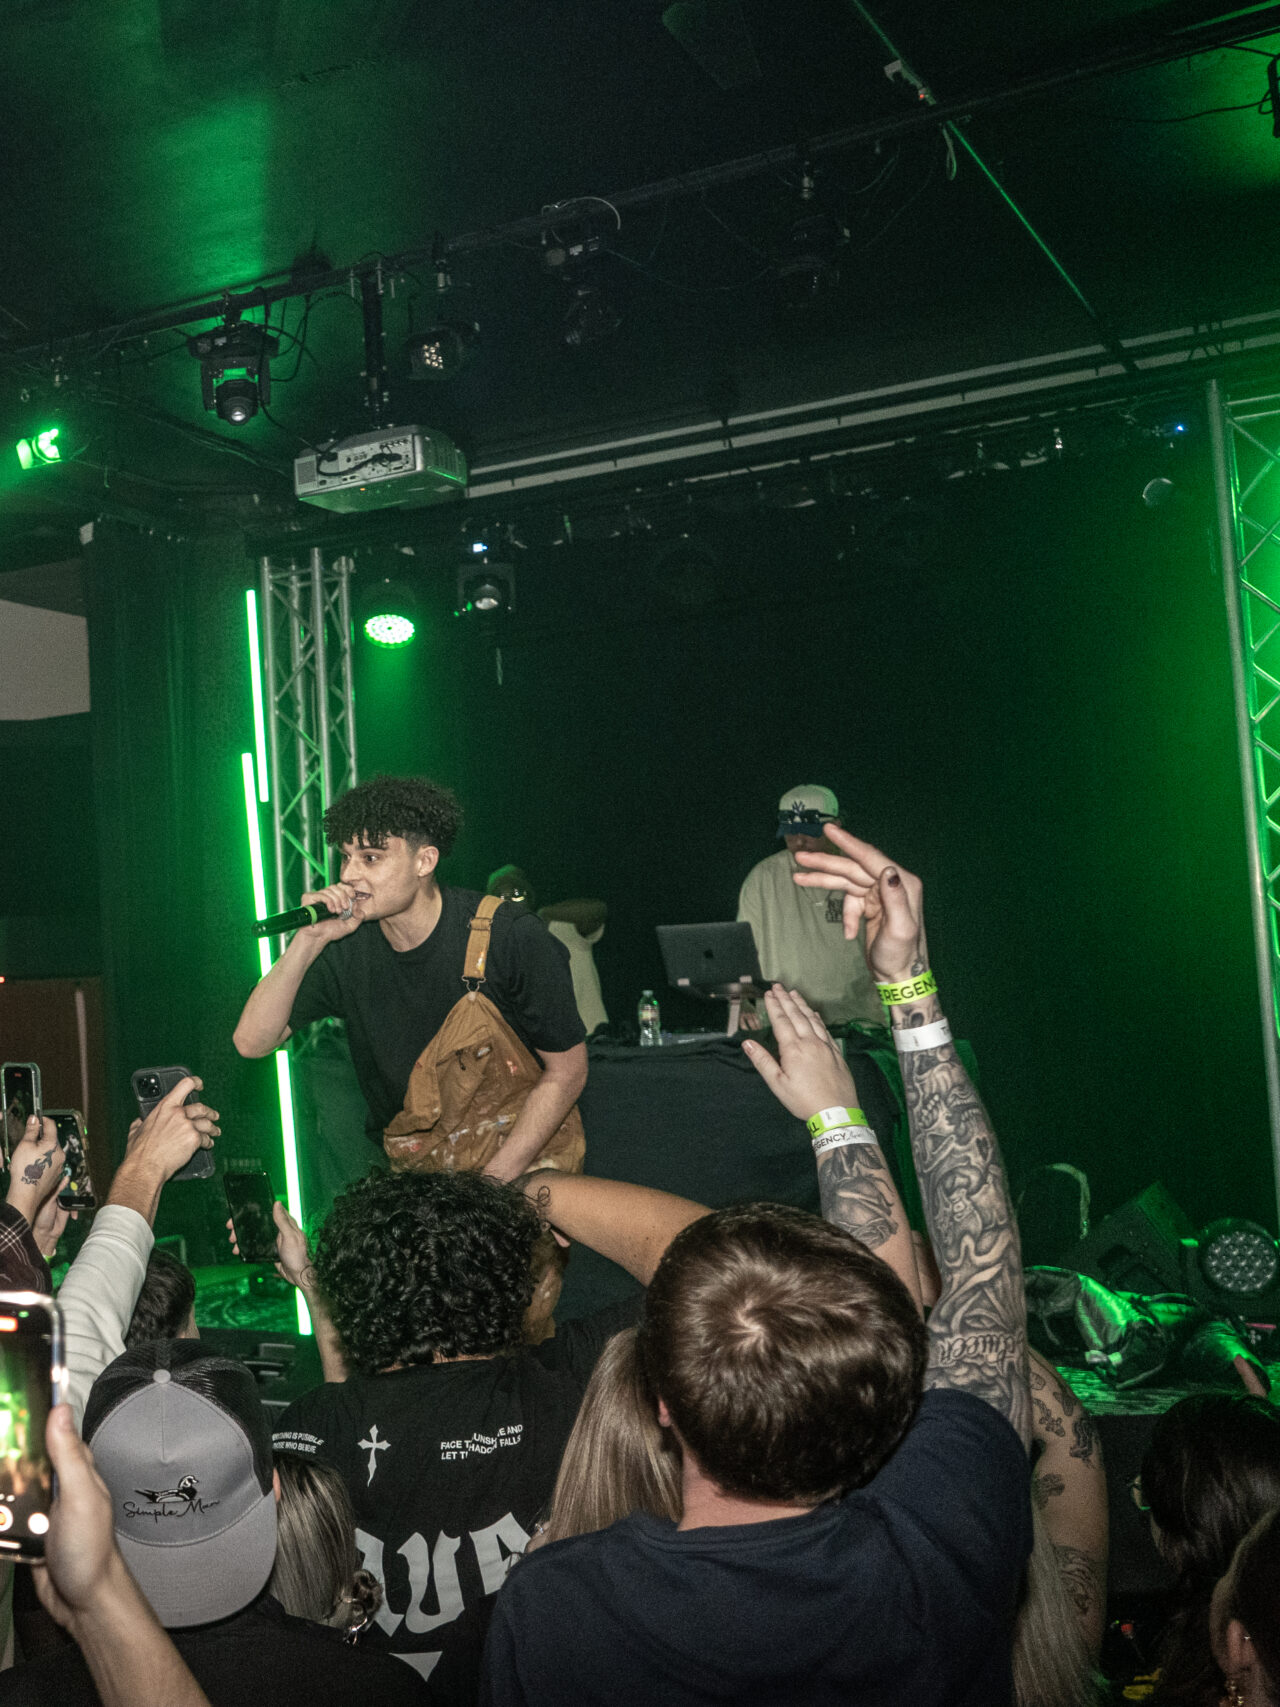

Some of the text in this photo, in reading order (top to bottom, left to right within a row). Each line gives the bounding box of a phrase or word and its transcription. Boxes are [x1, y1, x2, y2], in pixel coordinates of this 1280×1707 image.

[507, 1424, 523, 1435] AND
[440, 1440, 463, 1450] FACE
[441, 1451, 458, 1460] LET
[123, 1501, 178, 1524] Simple
